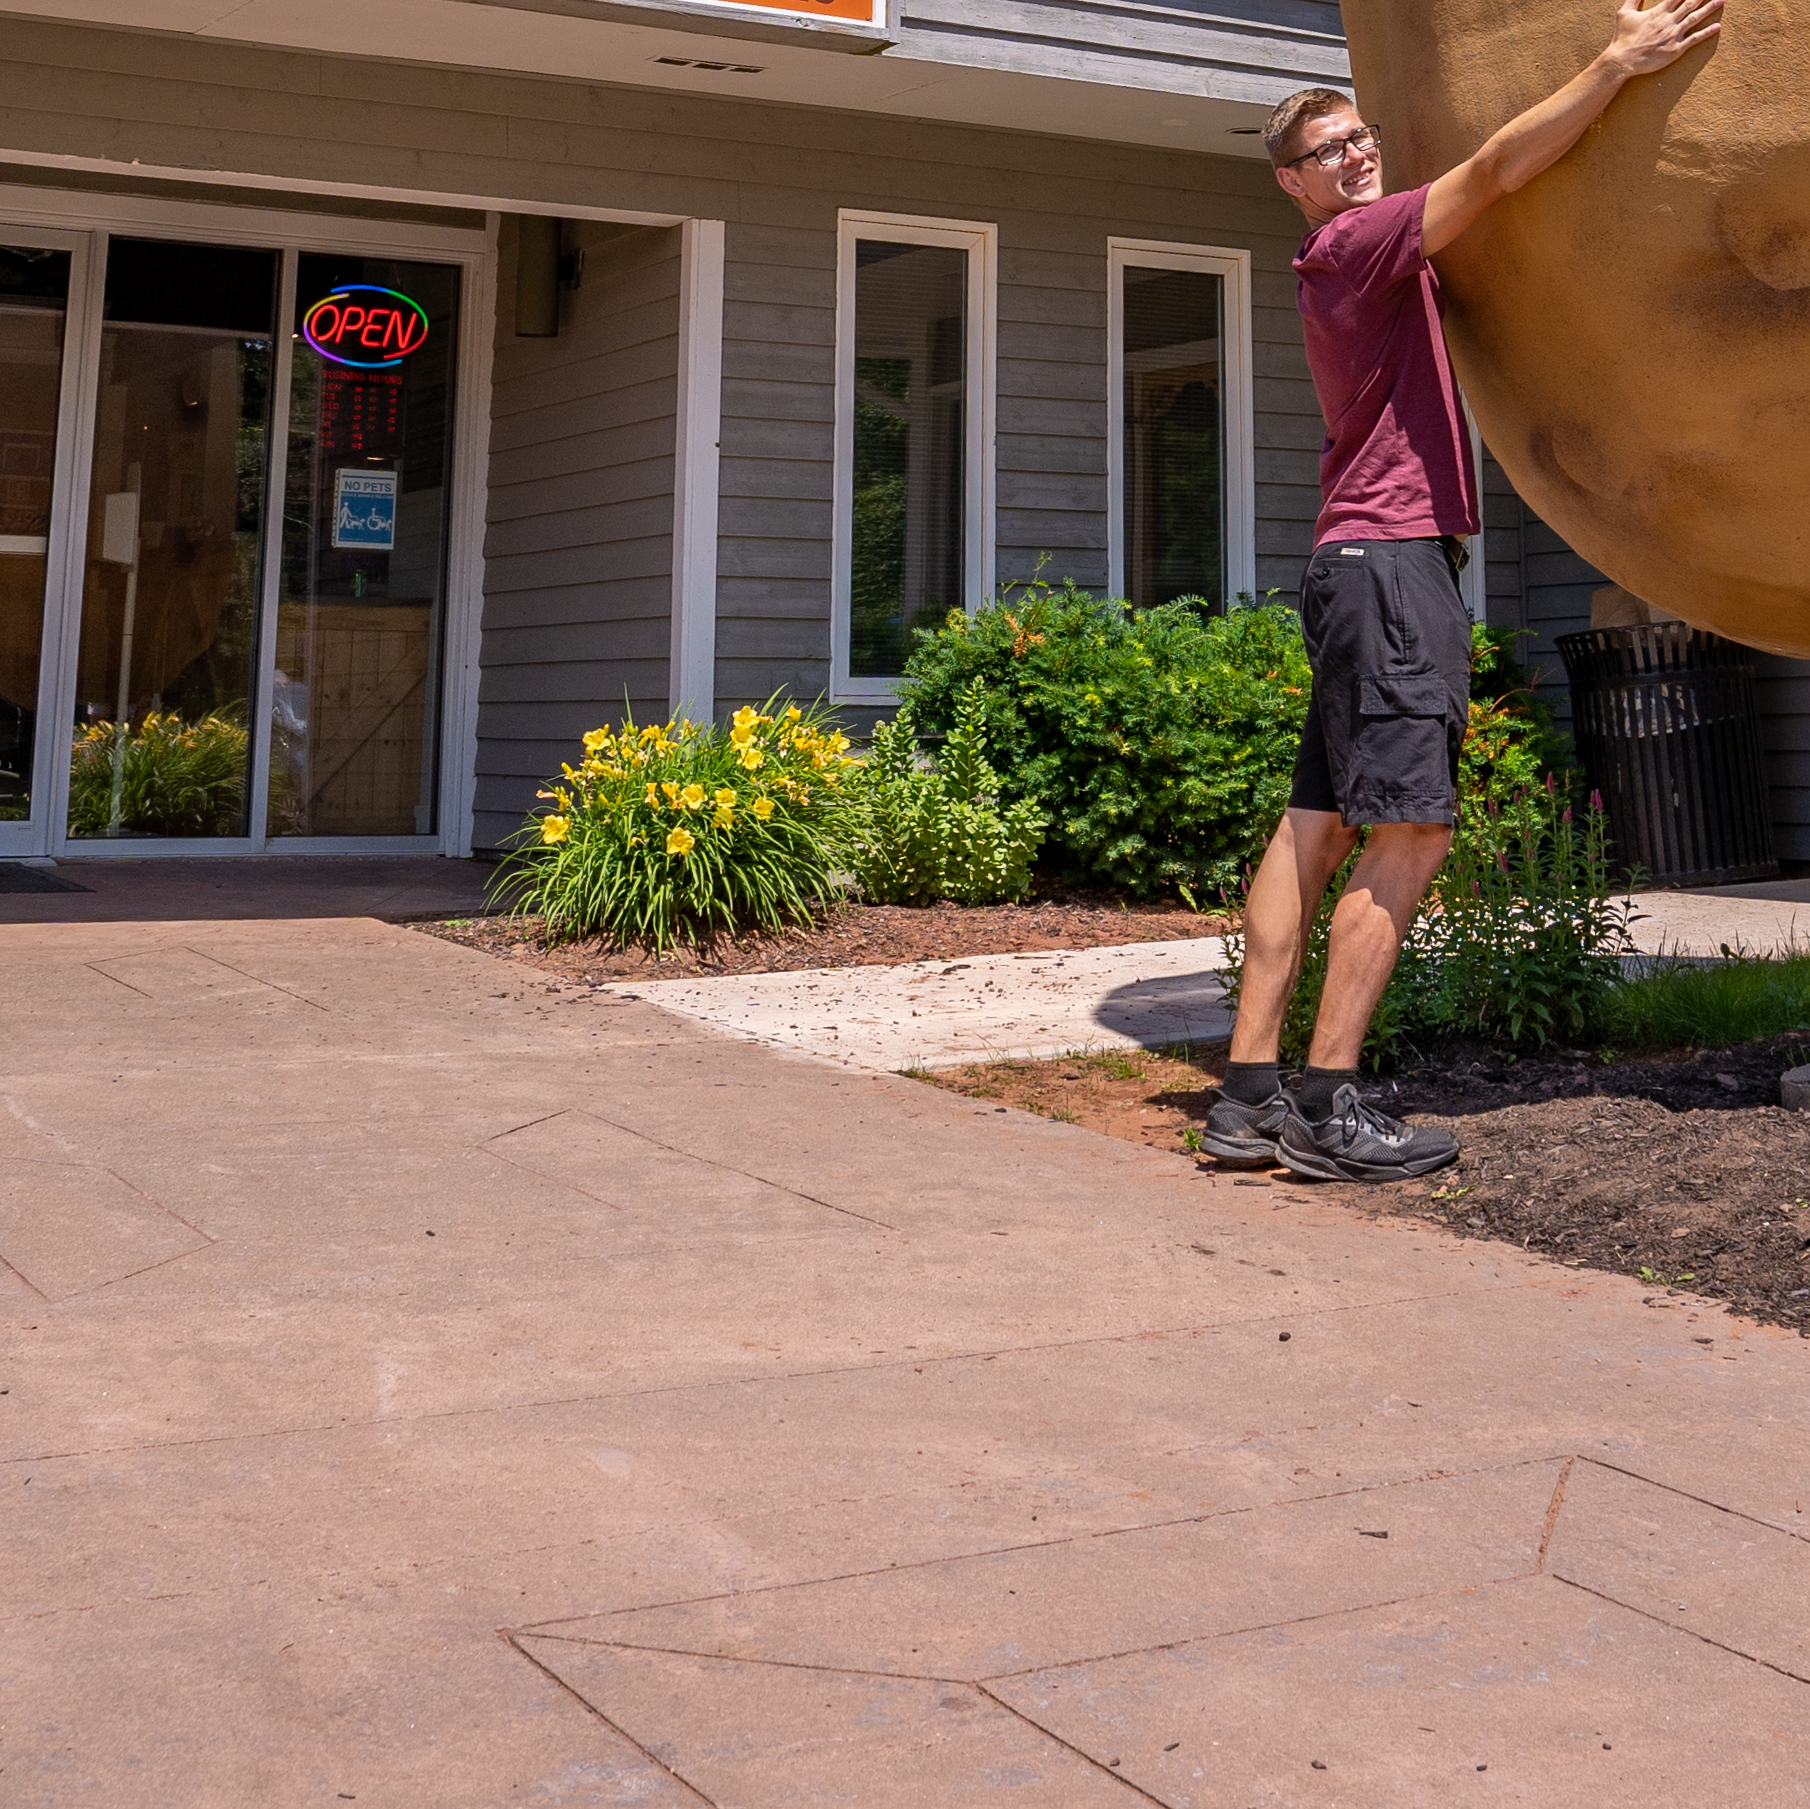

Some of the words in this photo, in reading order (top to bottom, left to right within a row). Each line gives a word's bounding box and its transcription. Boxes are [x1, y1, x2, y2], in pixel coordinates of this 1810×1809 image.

[311, 305, 417, 350] OPEN
[344, 481, 361, 490] NO
[364, 482, 392, 492] PETS
